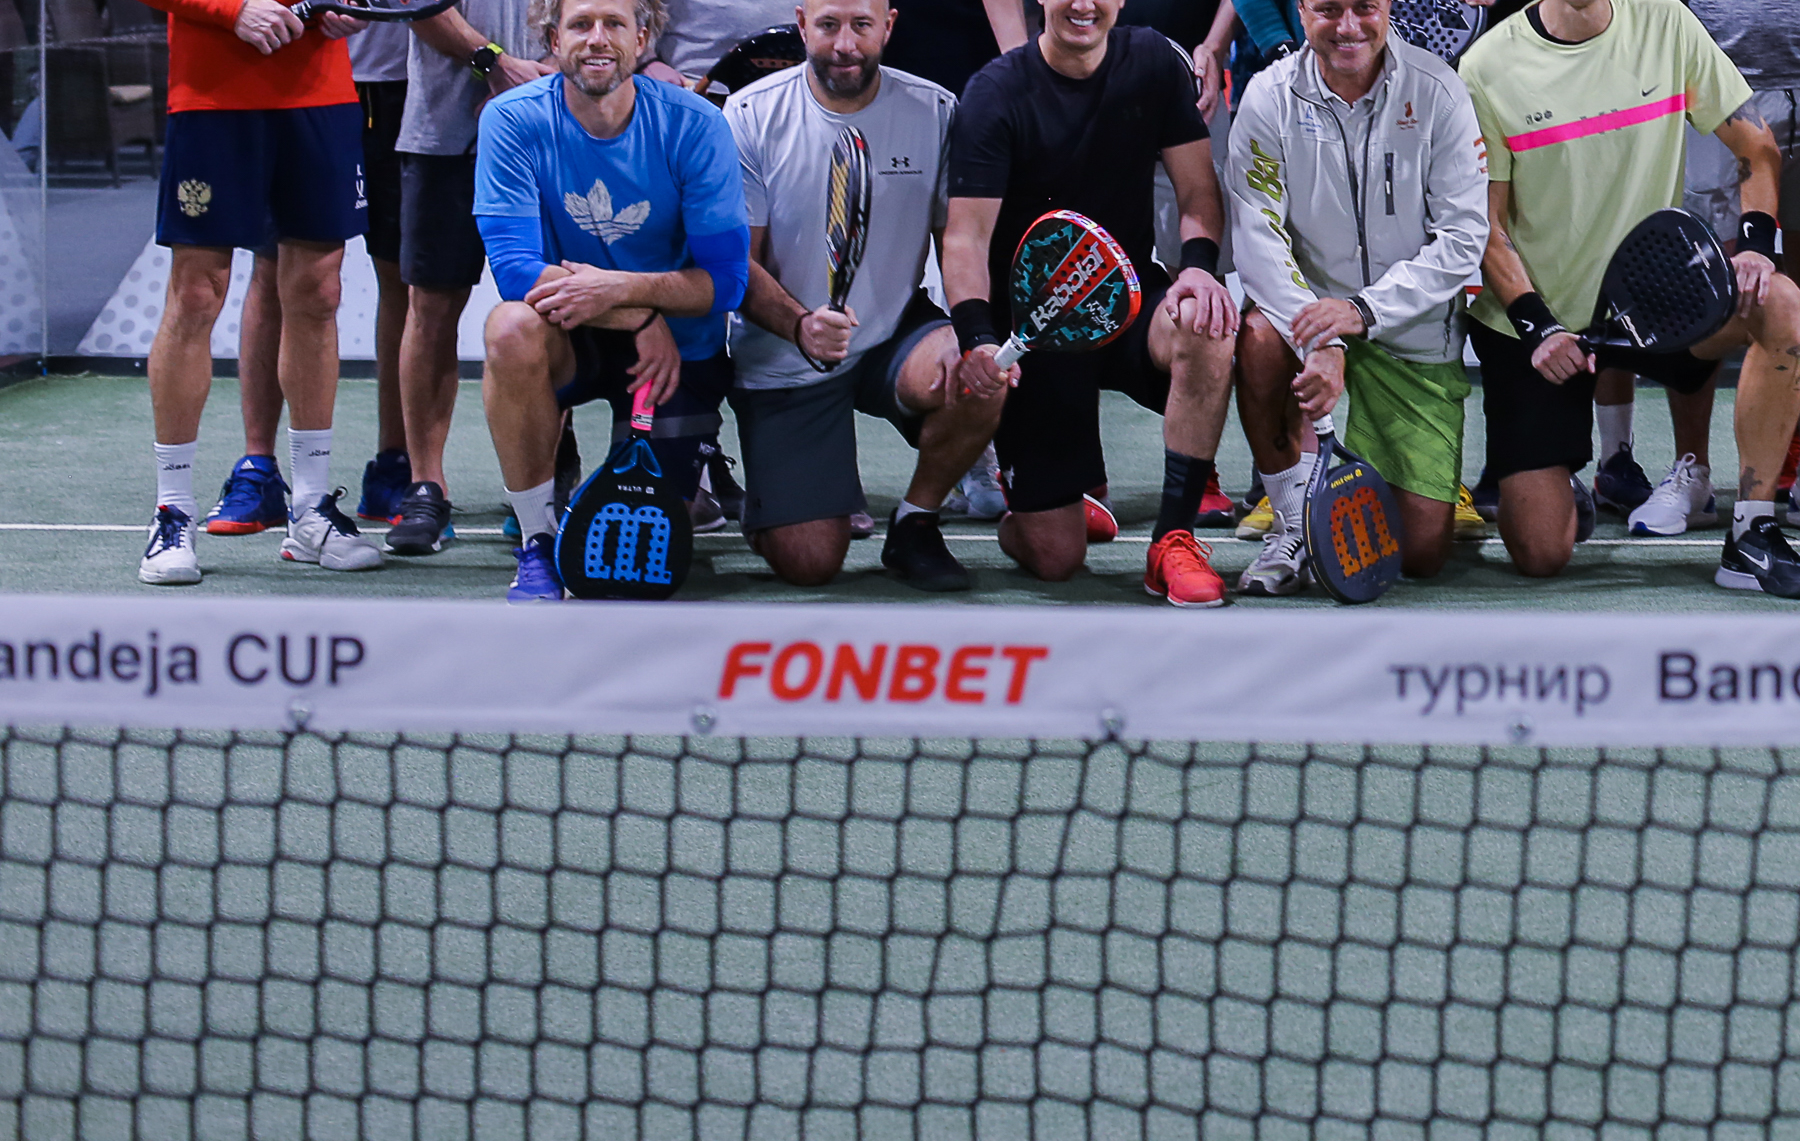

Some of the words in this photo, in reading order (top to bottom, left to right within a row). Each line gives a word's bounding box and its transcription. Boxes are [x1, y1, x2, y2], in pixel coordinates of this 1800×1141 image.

[225, 632, 366, 689] CUP
[718, 640, 1050, 705] FONBET
[1390, 664, 1611, 716] турнир
